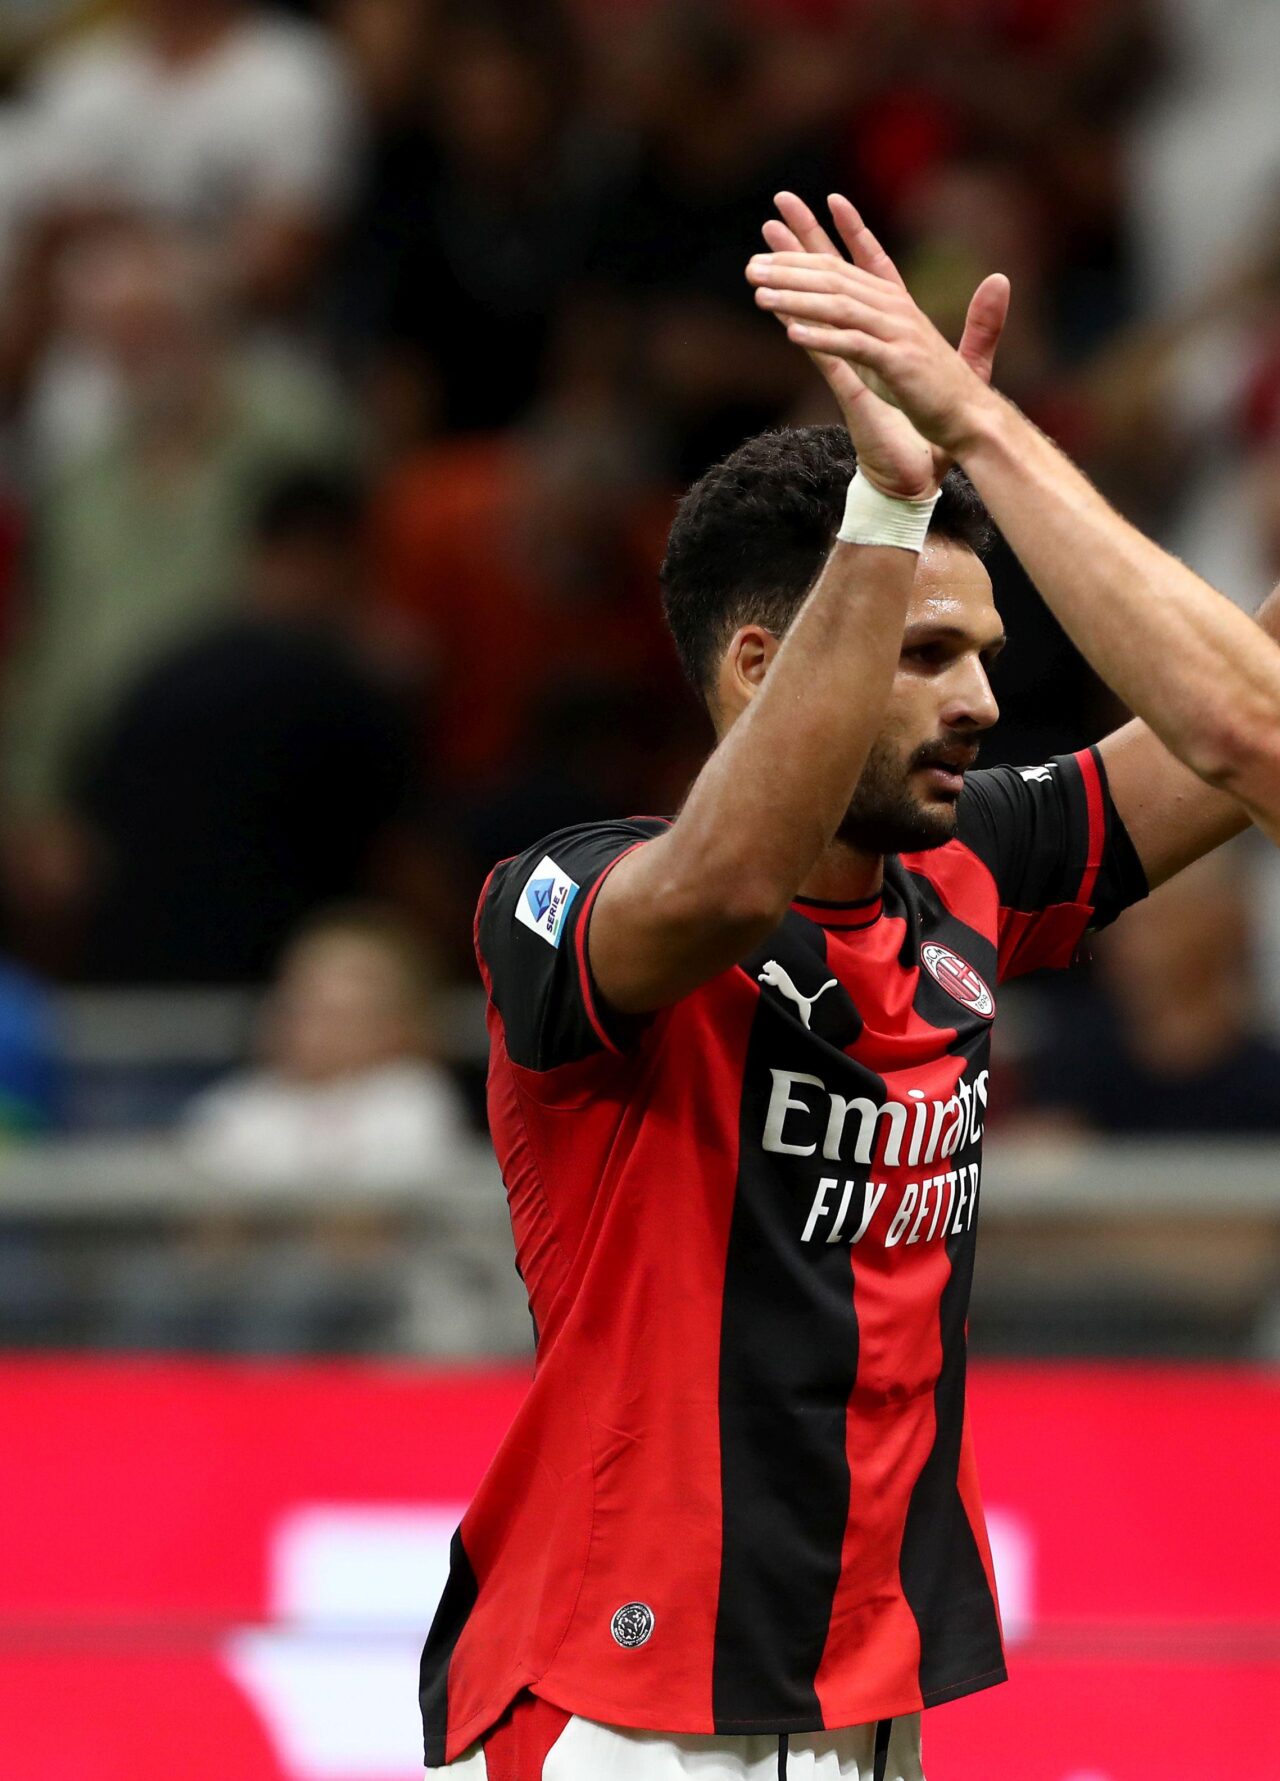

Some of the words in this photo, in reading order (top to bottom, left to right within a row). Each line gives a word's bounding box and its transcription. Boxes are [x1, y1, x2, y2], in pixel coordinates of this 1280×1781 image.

[546, 896, 560, 932] SERIE
[800, 1177, 887, 1244] FLY
[884, 1162, 979, 1248] BETTER
